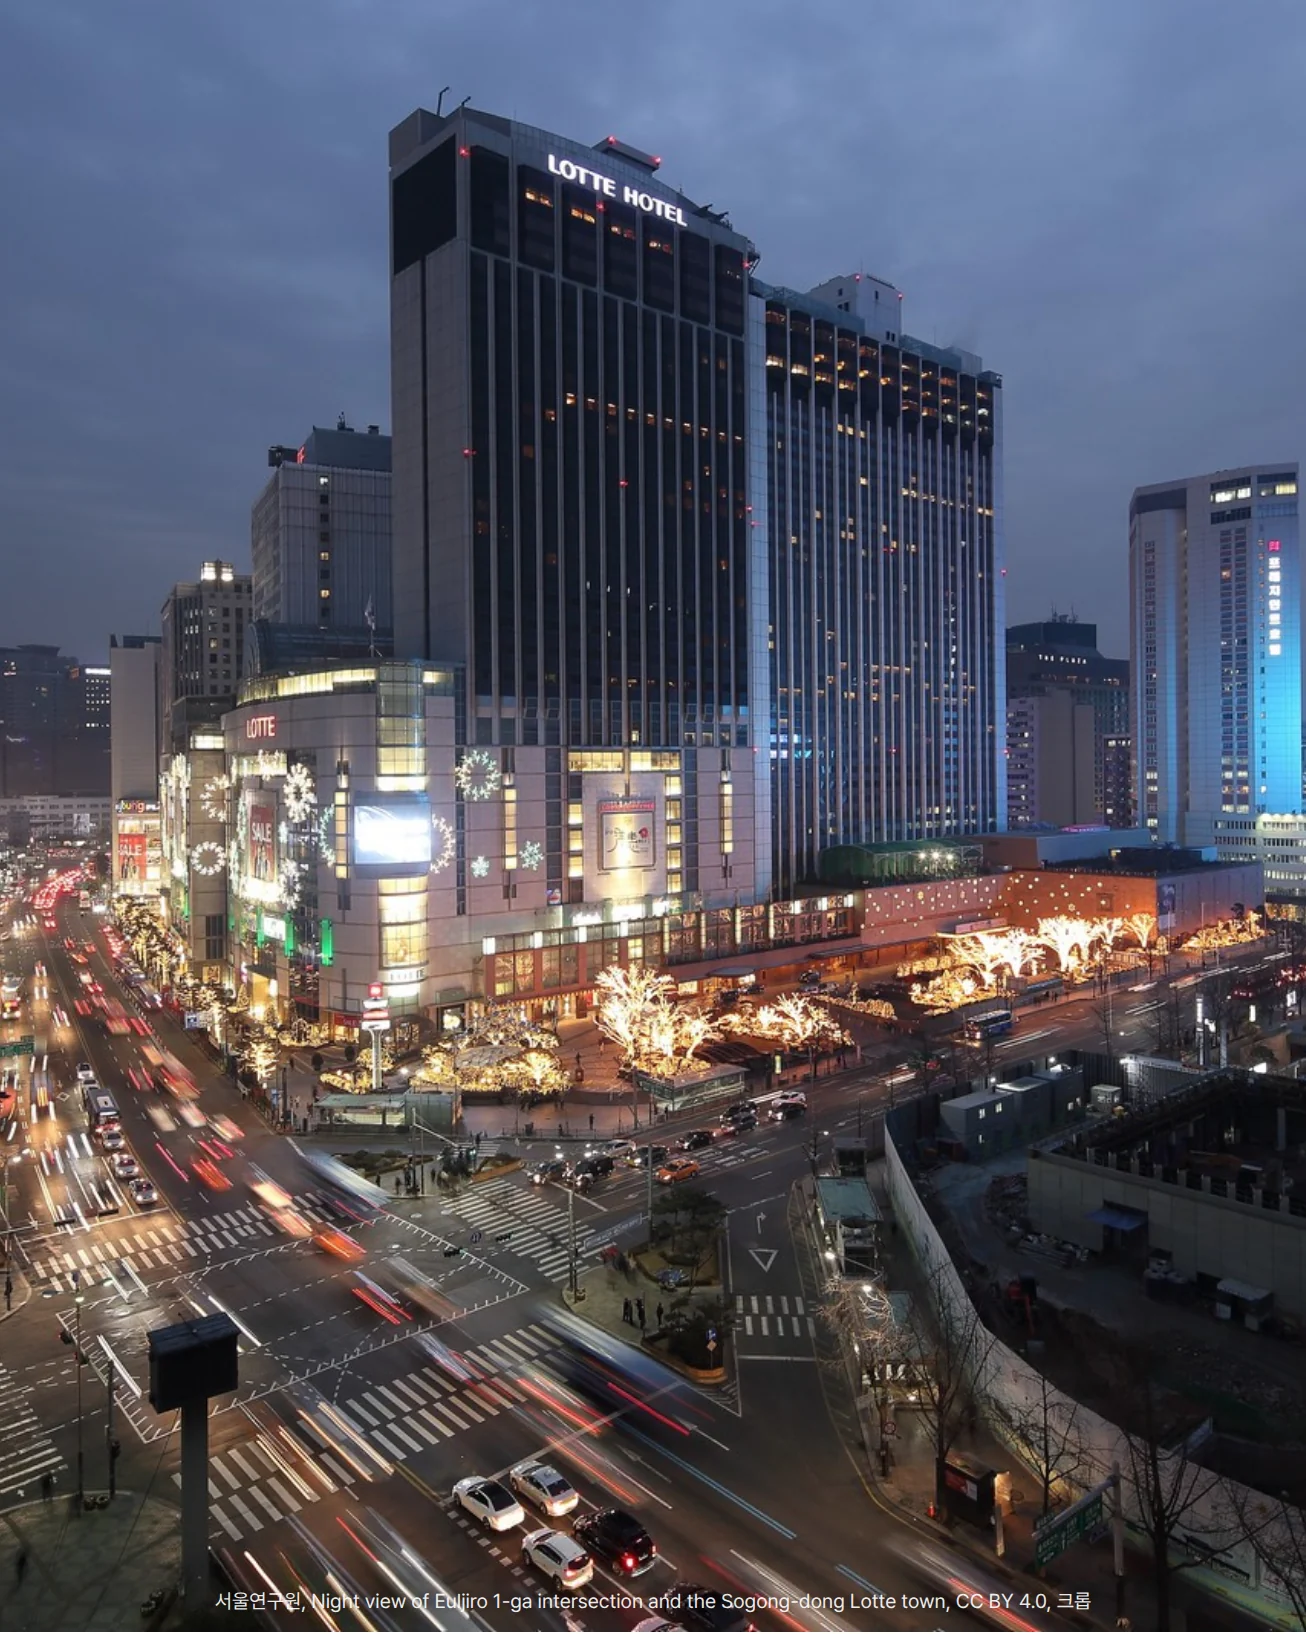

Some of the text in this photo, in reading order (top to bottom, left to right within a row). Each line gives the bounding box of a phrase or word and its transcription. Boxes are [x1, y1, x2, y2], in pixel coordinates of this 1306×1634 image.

[547, 153, 688, 227] LOTTE HOTEL
[246, 716, 276, 738] LOTTE
[252, 822, 272, 842] SALE
